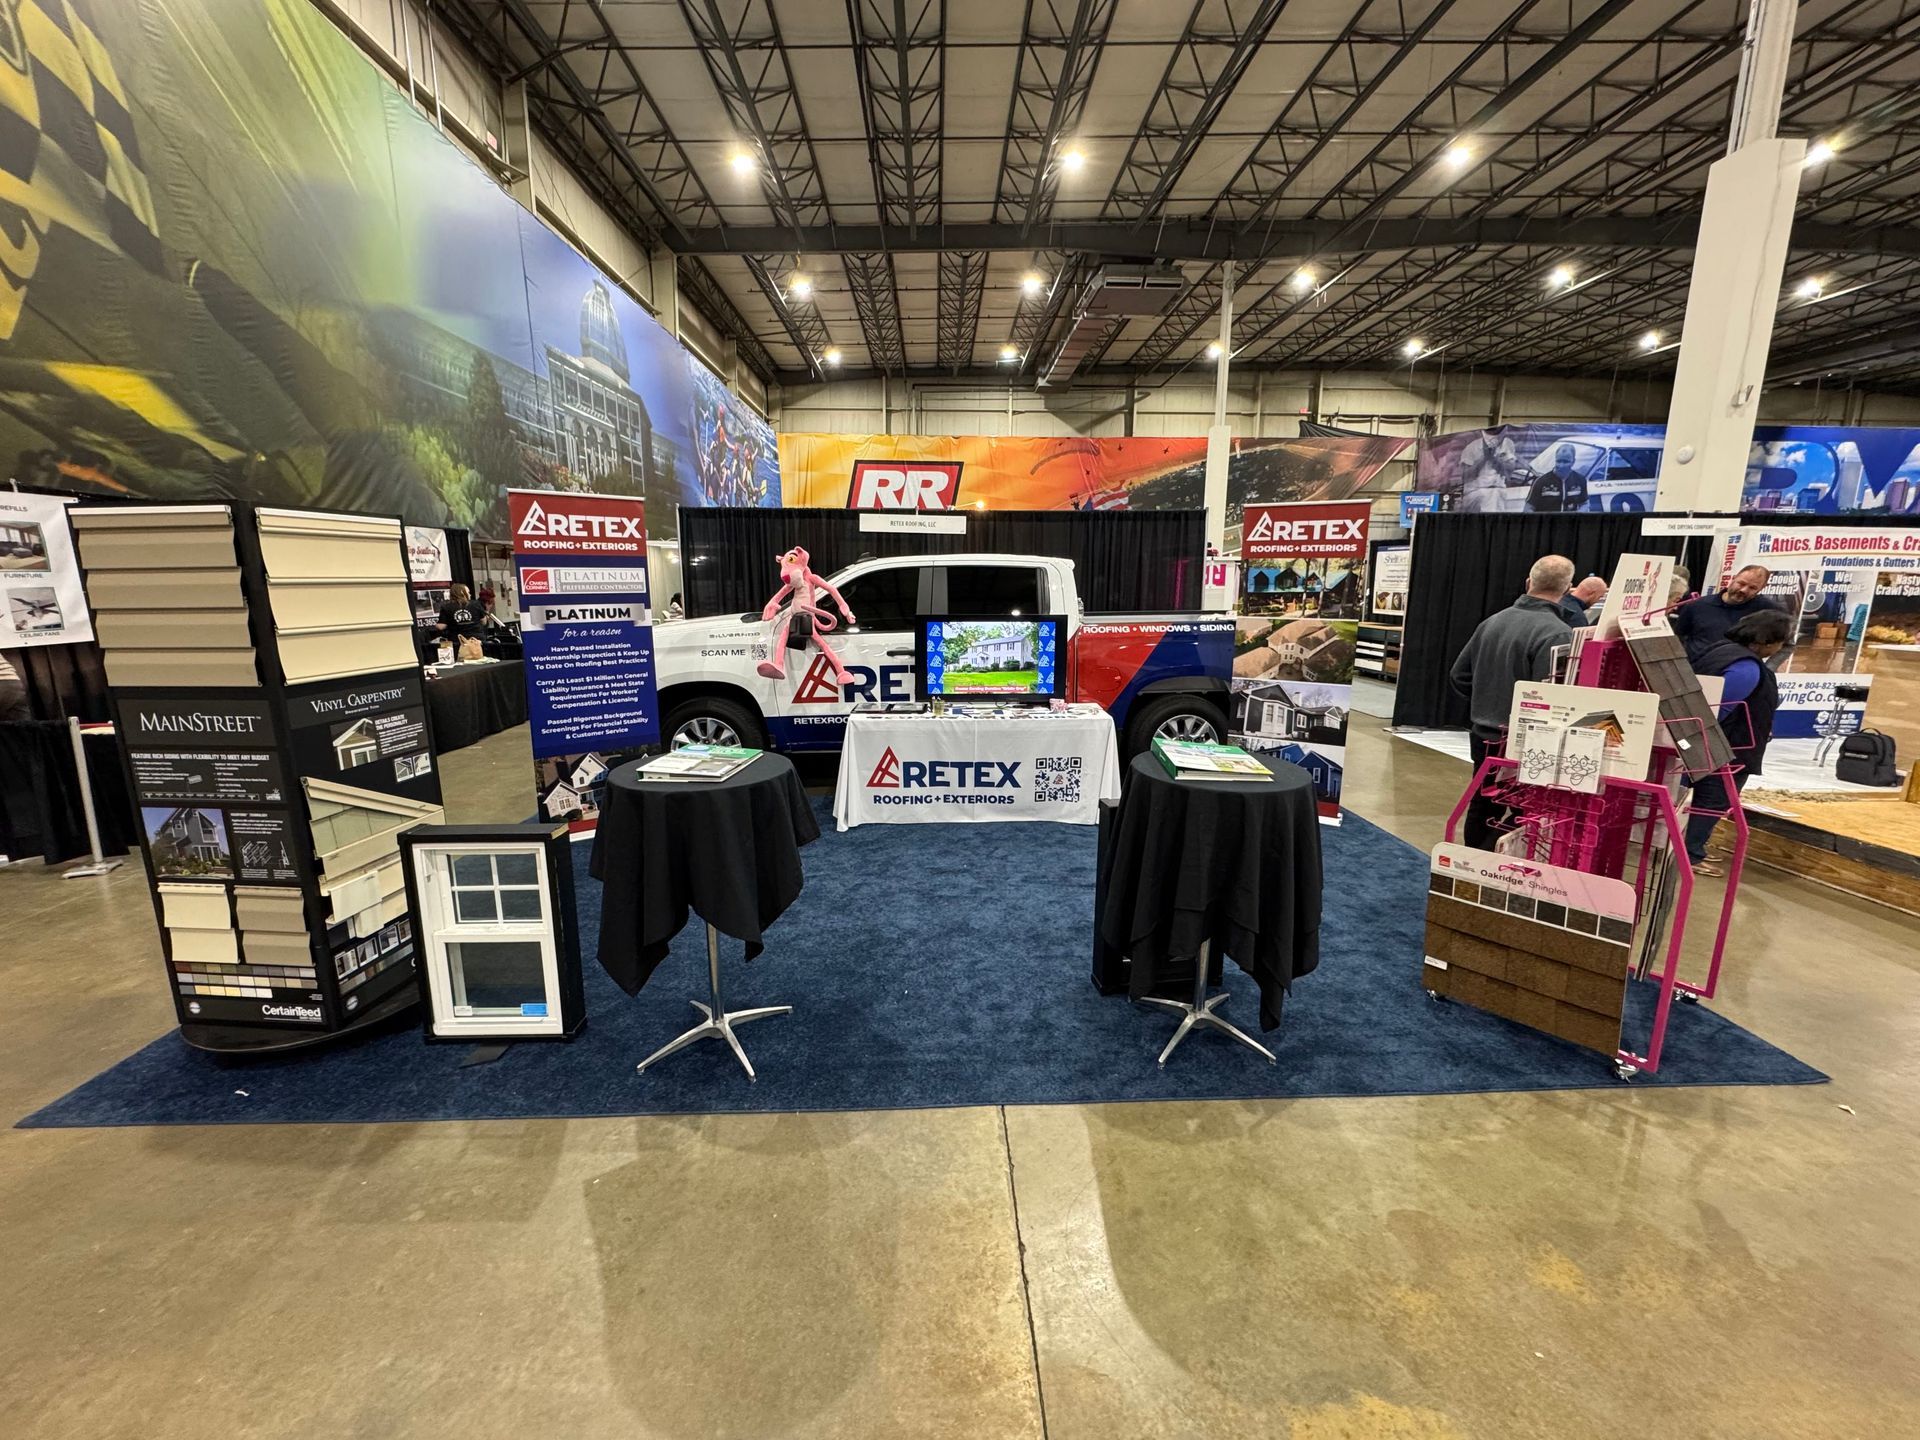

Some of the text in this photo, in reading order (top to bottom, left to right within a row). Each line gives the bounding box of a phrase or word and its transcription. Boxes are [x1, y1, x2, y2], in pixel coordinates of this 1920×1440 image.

[857, 469, 949, 509] RR
[547, 513, 642, 539] RETEX
[1273, 519, 1365, 541] RETEX
[1758, 544, 1770, 553] Fix
[1814, 536, 1890, 550] Basements
[1892, 540, 1899, 550] &
[1760, 533, 1772, 542] We
[1821, 556, 1874, 567] Foundations
[1875, 558, 1881, 567] &
[1884, 558, 1914, 568] Gutters
[564, 572, 640, 581] PLATINUM
[1875, 584, 1902, 596] Crawl
[545, 607, 631, 621] PLATINUM
[560, 628, 579, 641] for
[591, 628, 622, 636] reason
[1084, 624, 1234, 634] ROOFING WINDOWS SIDING
[595, 642, 631, 650] Installation
[531, 654, 580, 662] Workmanship
[582, 652, 616, 660] Inspection
[576, 660, 602, 668] Roofing
[536, 680, 556, 688] Carry
[594, 674, 616, 682] Million
[844, 664, 915, 703] RE
[542, 686, 570, 694] Liability
[571, 684, 604, 692] Insurance
[550, 693, 598, 702] Requirements
[610, 688, 640, 696] Workers'
[310, 688, 402, 712] VINYL CARPENTRY
[552, 700, 601, 710] Compensation
[608, 696, 638, 704] Licensing
[547, 718, 572, 726] Passed
[604, 710, 642, 720] Background
[542, 726, 580, 734] Screenings
[593, 720, 622, 728] Financial
[623, 718, 648, 726] Stability
[572, 730, 604, 738] Customer
[902, 760, 1022, 789] RETEX
[1480, 869, 1568, 897] Oakridge Shingles
[262, 1004, 321, 1016] CertainTeed
